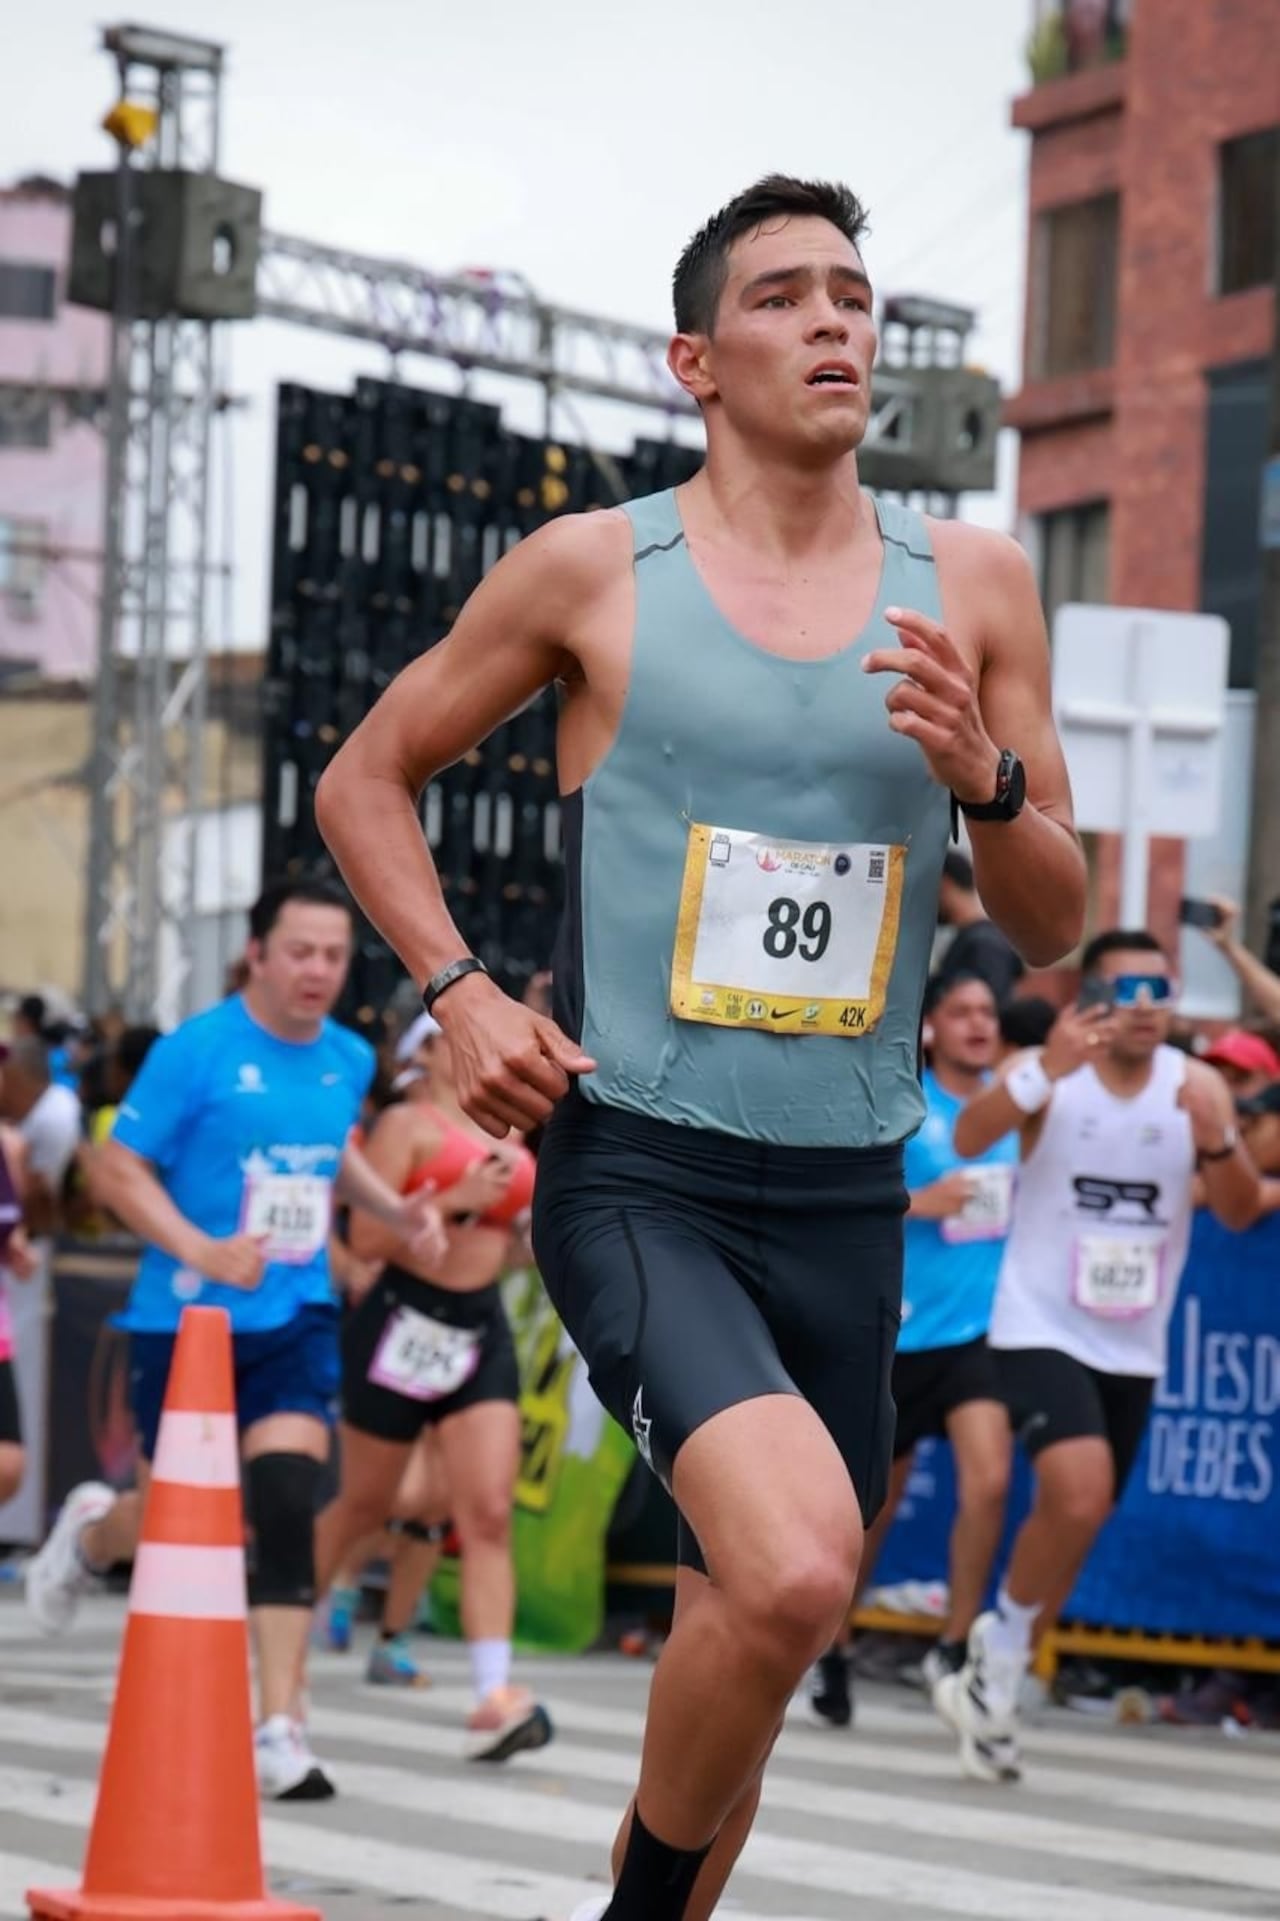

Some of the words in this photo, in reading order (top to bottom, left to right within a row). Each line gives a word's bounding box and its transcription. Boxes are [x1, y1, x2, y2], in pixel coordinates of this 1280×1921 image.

[763, 897, 831, 962] 89
[839, 1007, 867, 1028] 42K
[1072, 1176, 1160, 1215] SR
[1204, 1332, 1250, 1414] ES
[1147, 1414, 1273, 1503] DEBES
